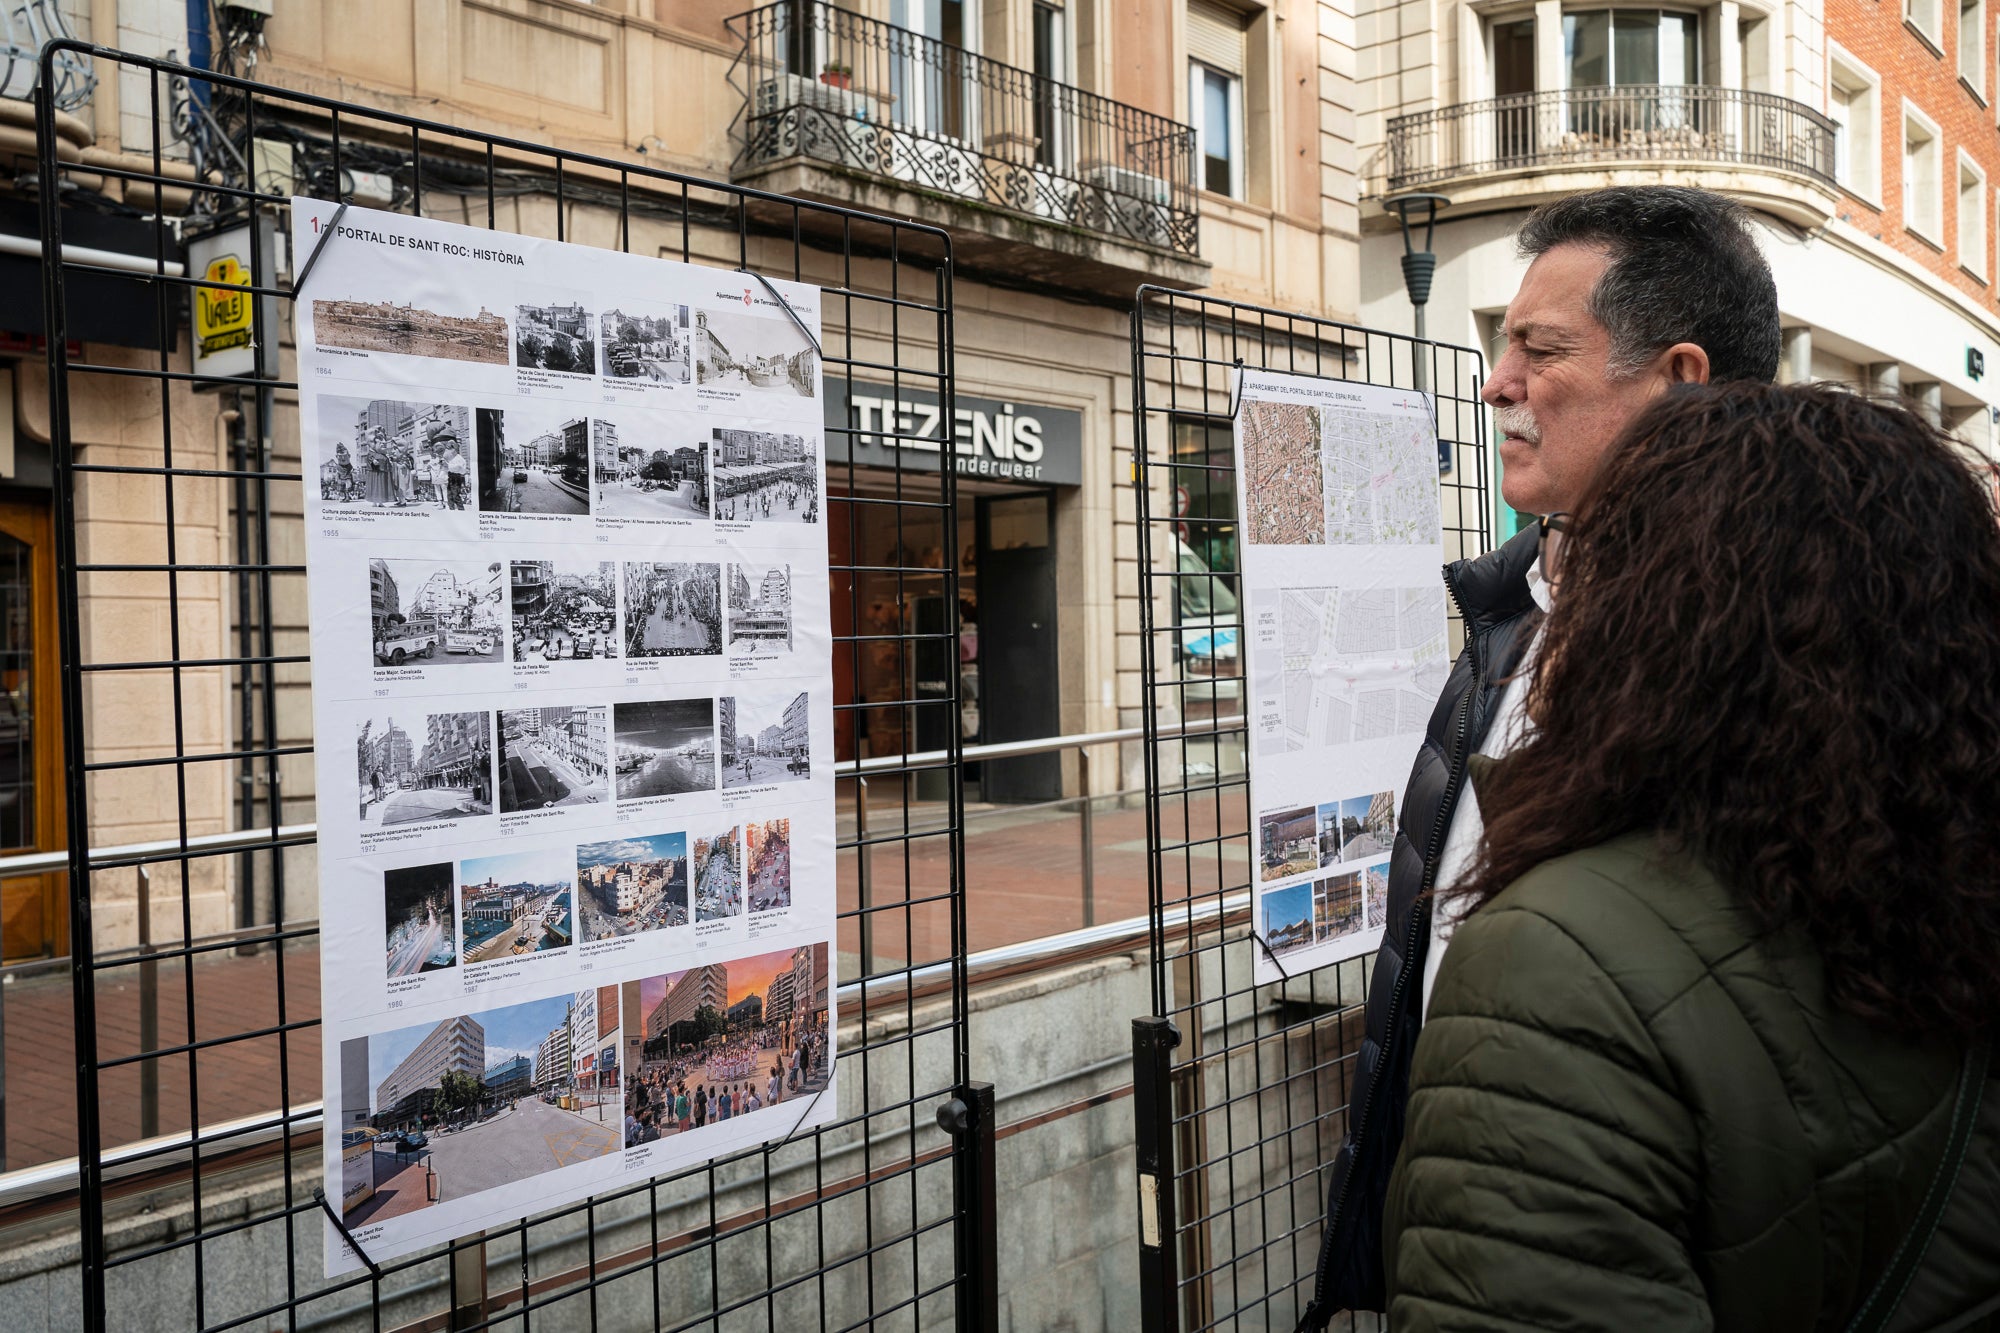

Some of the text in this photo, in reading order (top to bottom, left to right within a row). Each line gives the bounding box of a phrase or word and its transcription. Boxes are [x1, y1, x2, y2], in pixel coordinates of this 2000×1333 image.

[337, 226, 386, 244] PORTAL
[390, 234, 404, 246] DE
[408, 238, 439, 252] SANT
[443, 243, 470, 257] ROC:
[473, 249, 525, 265] HISTÒRIA
[716, 292, 742, 302] Ajuntament
[760, 299, 779, 307] Terrassa
[948, 456, 1042, 478] nderwear
[361, 844, 376, 853] 1972
[604, 1049, 613, 1060] P
[625, 1159, 645, 1170] FUTUR
